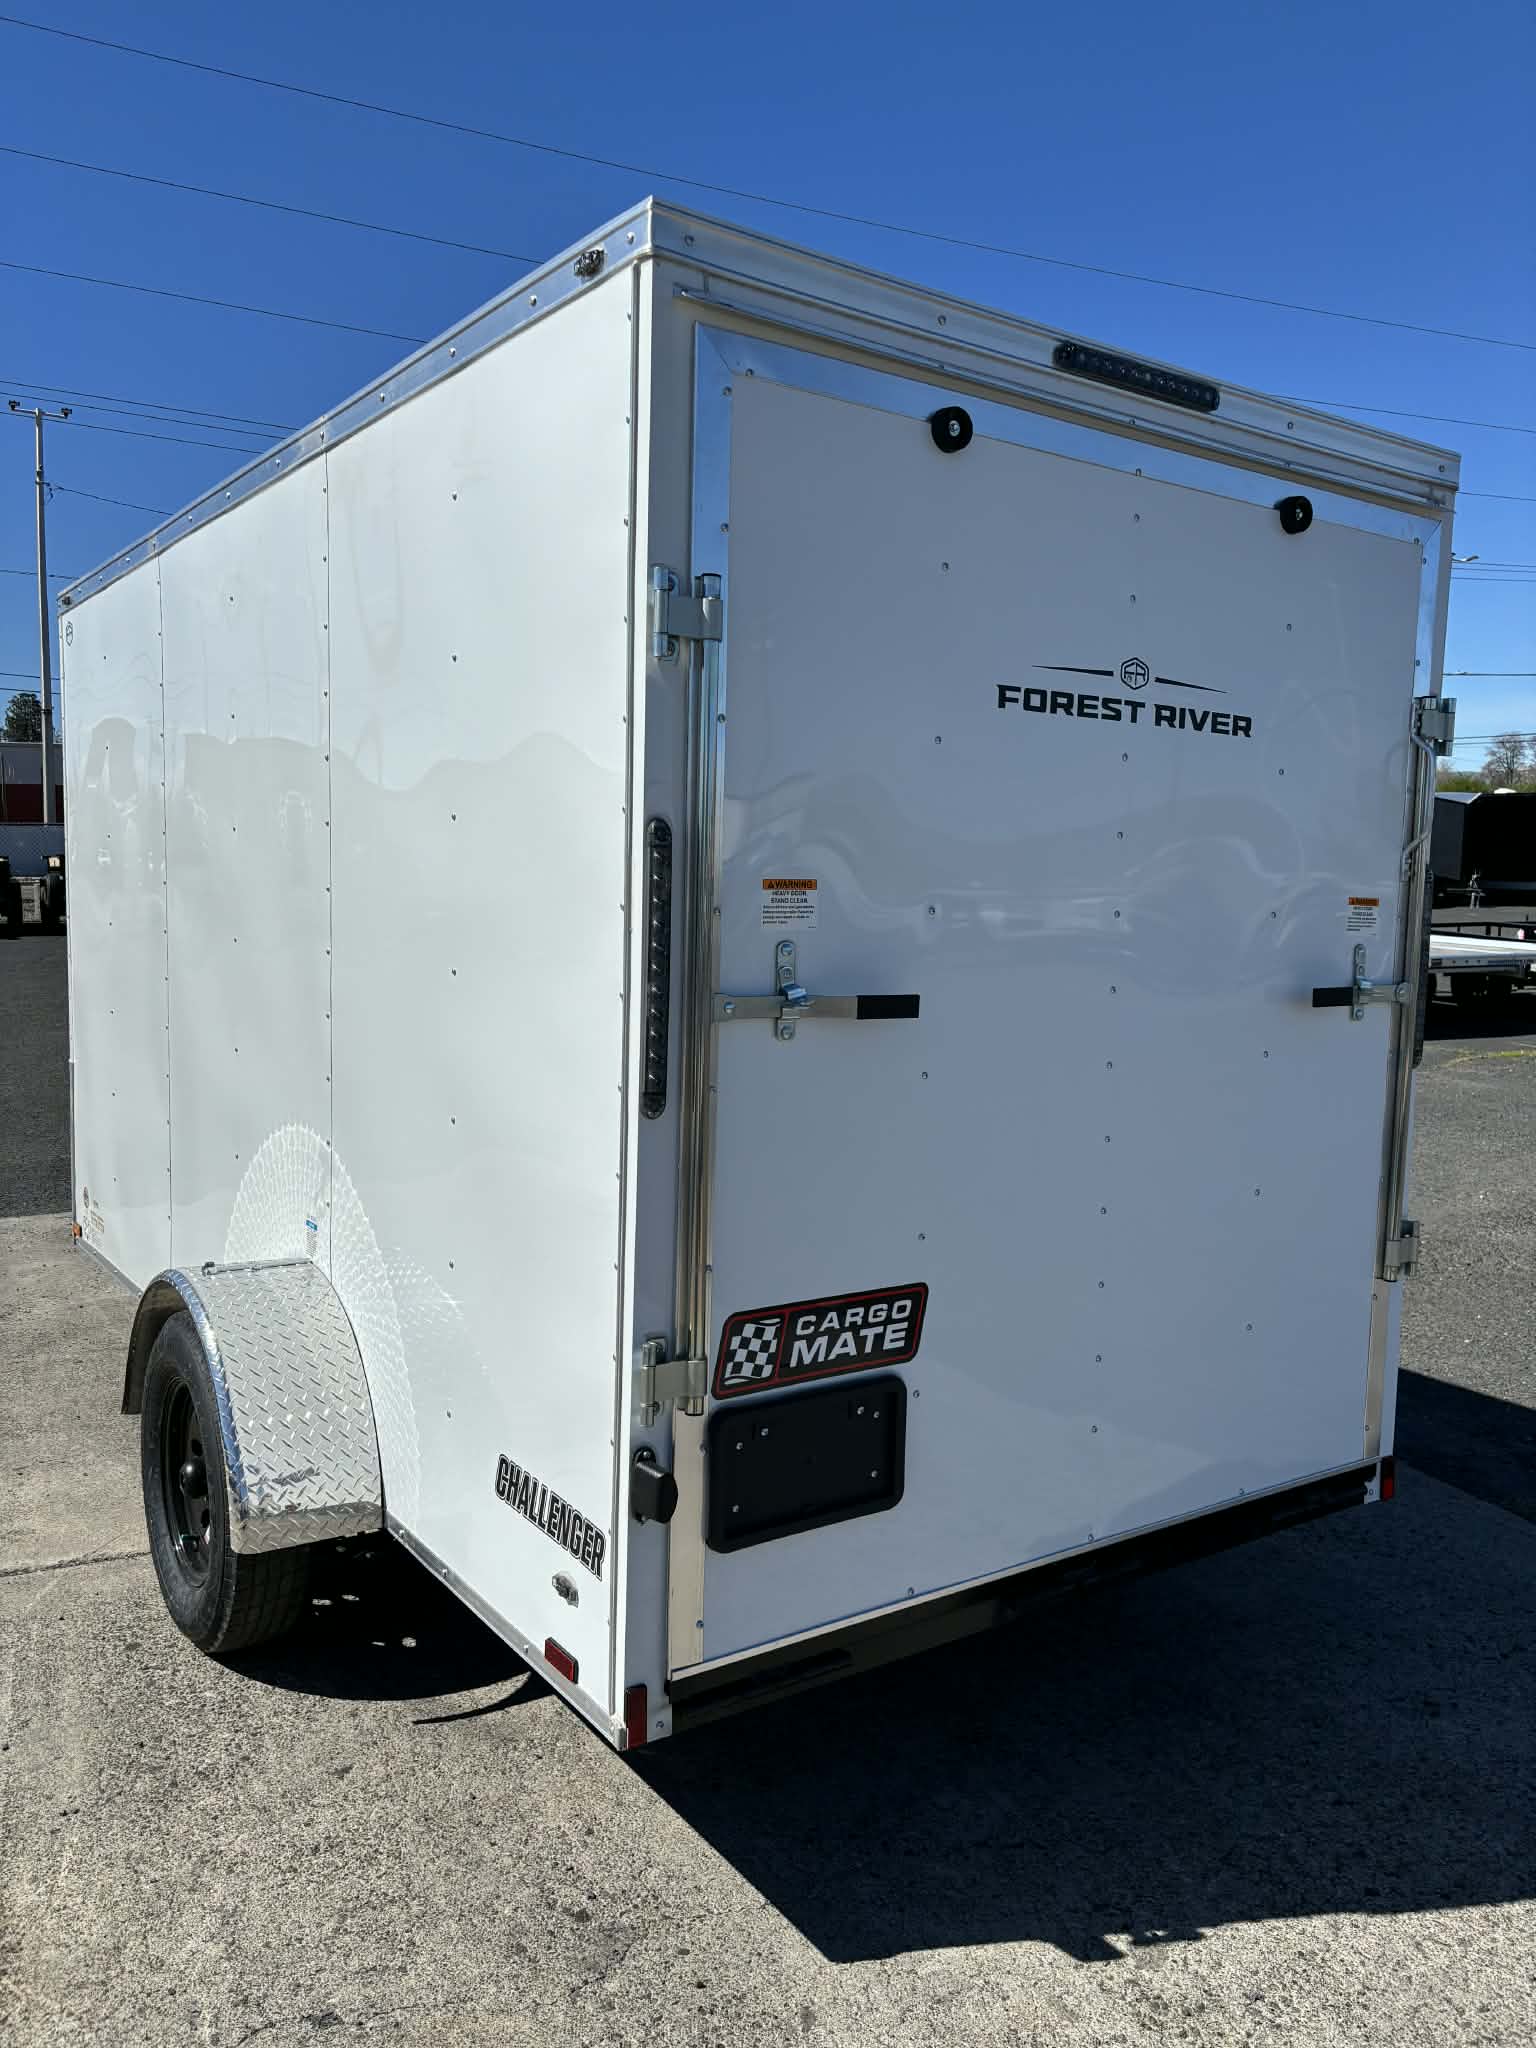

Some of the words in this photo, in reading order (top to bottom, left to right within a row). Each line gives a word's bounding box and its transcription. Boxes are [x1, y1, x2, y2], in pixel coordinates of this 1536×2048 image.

[997, 684, 1146, 724] FOREST
[1154, 703, 1252, 738] RIVER
[775, 880, 813, 889] WARNING
[795, 1299, 912, 1336] CARGO
[790, 1321, 909, 1368] MATE
[495, 1453, 606, 1582] CHALLENGER
